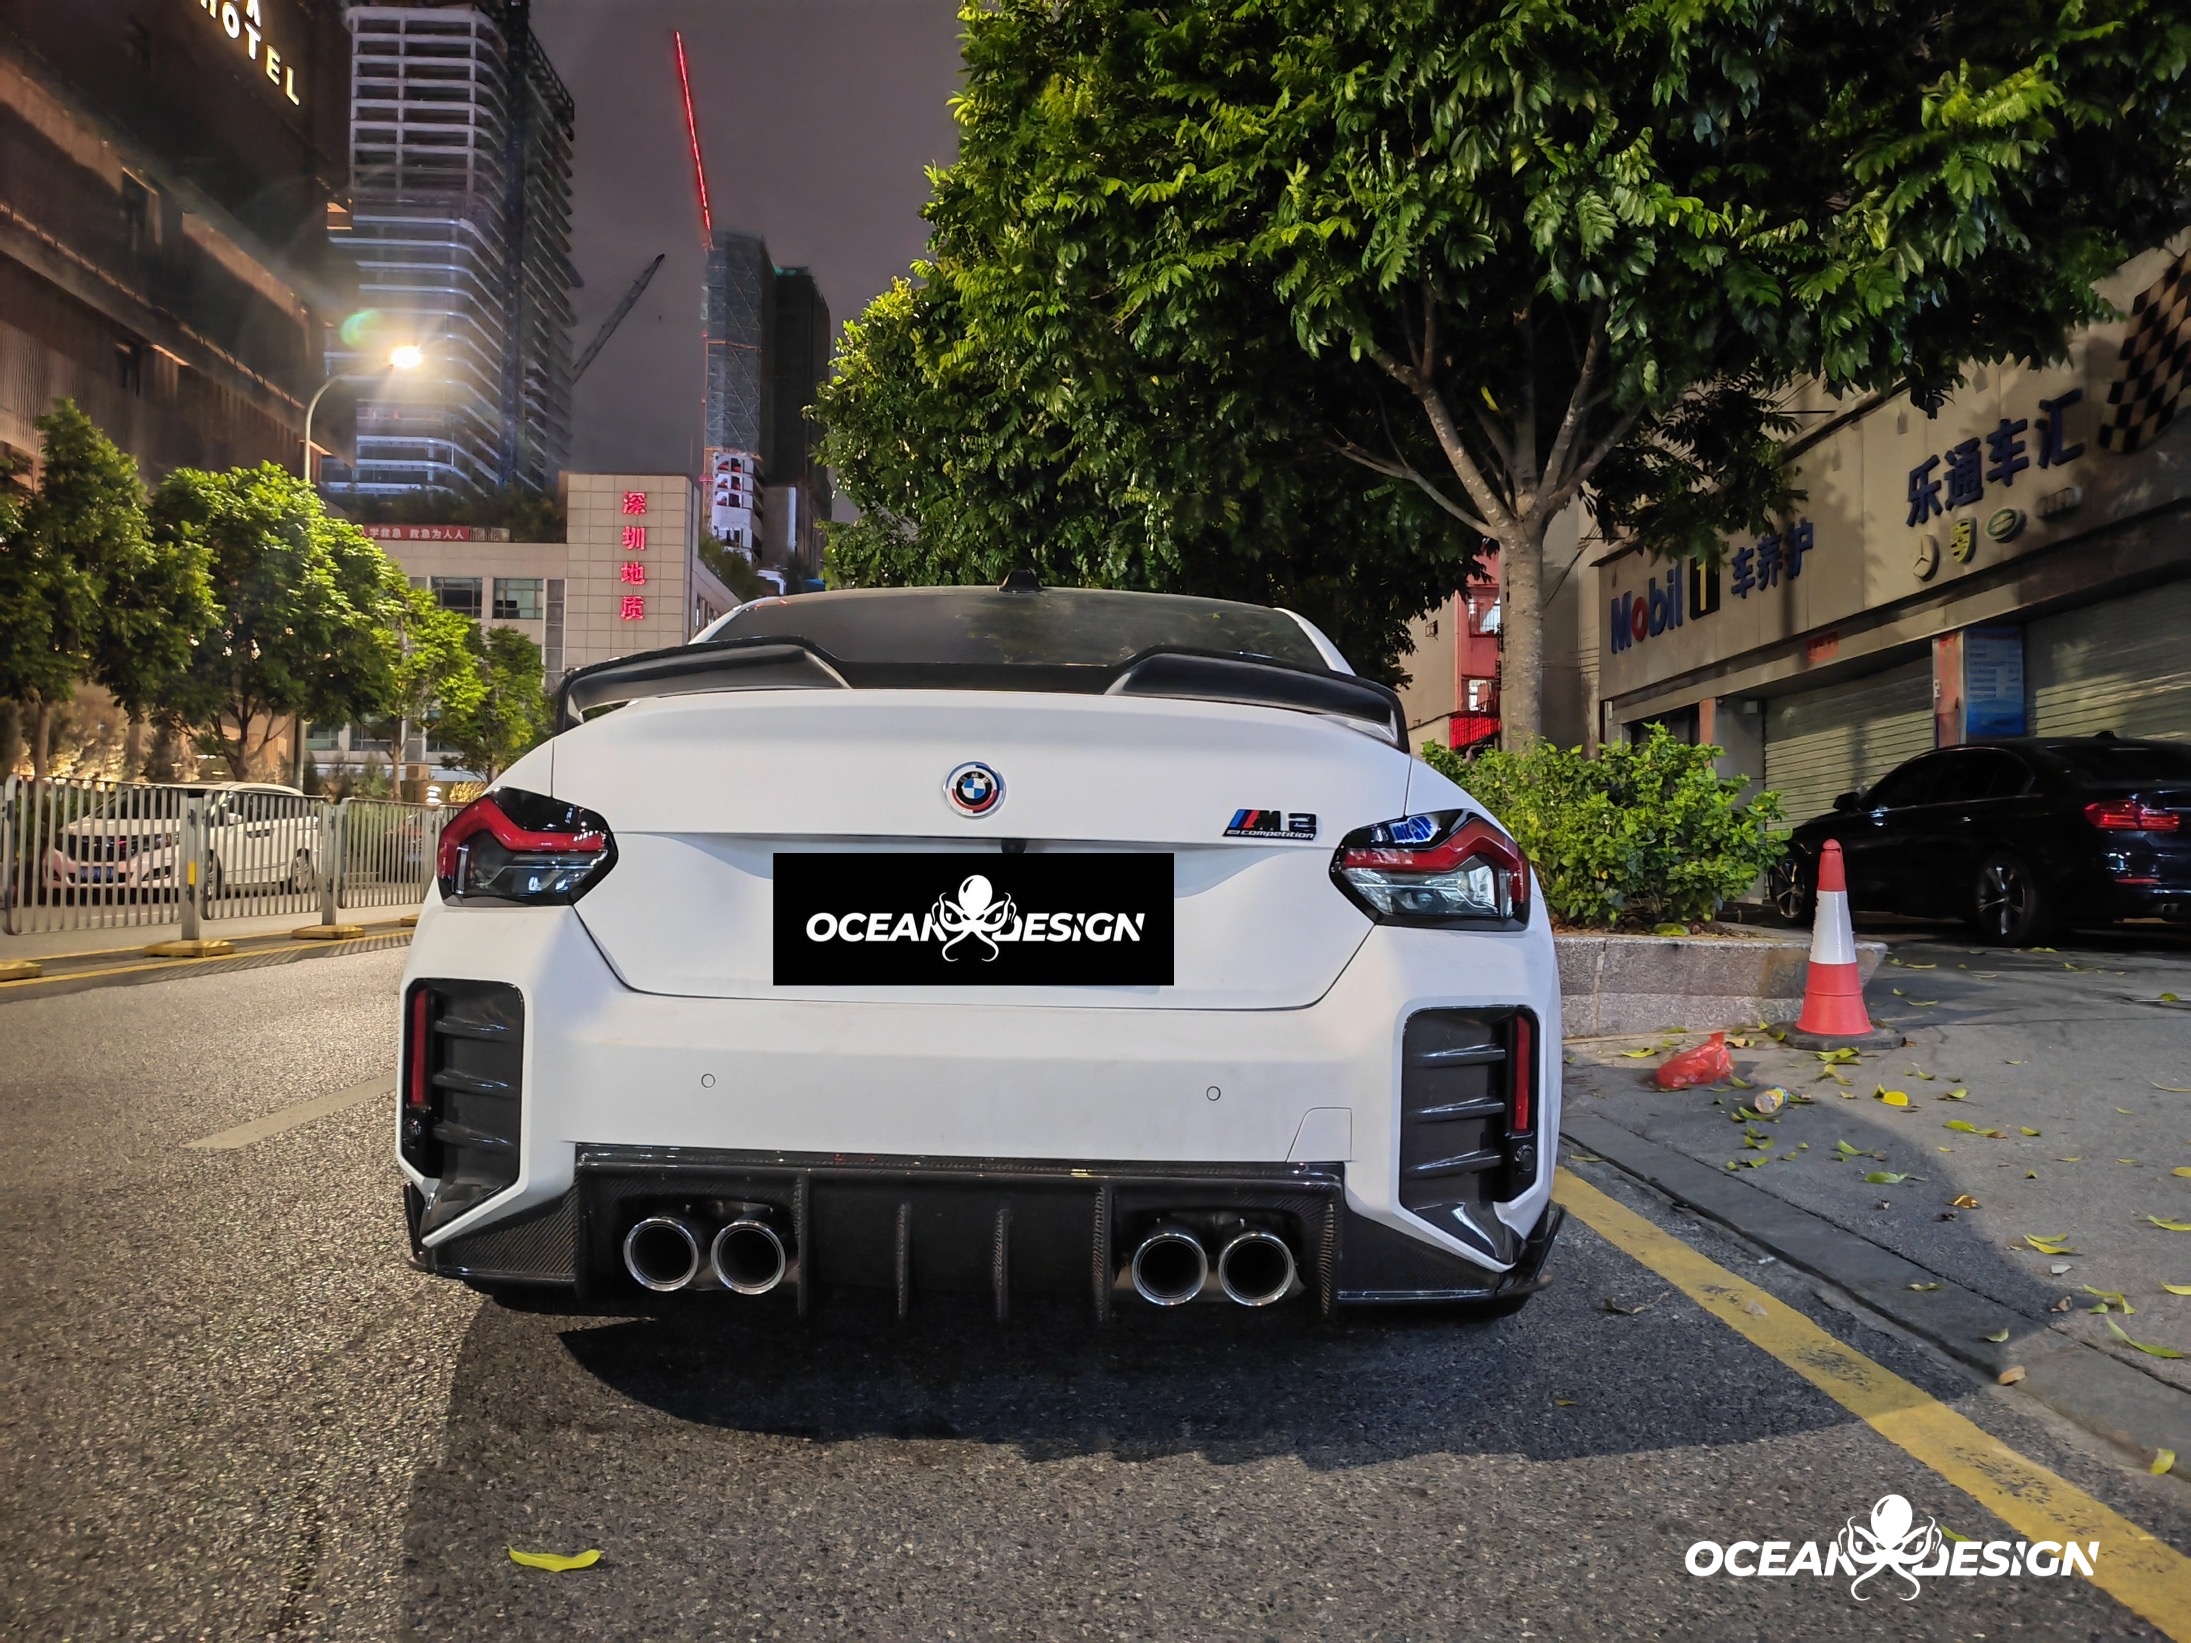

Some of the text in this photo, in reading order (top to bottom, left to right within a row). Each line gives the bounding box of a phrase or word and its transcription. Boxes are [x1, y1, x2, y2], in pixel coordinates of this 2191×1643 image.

[1906, 388, 2086, 527] 乐通车汇
[620, 491, 647, 621] 深圳地质
[1611, 557, 1683, 655] Mobil
[1731, 518, 1814, 599] 车养护
[1241, 829, 1315, 839] competition
[1249, 809, 1317, 832] M2
